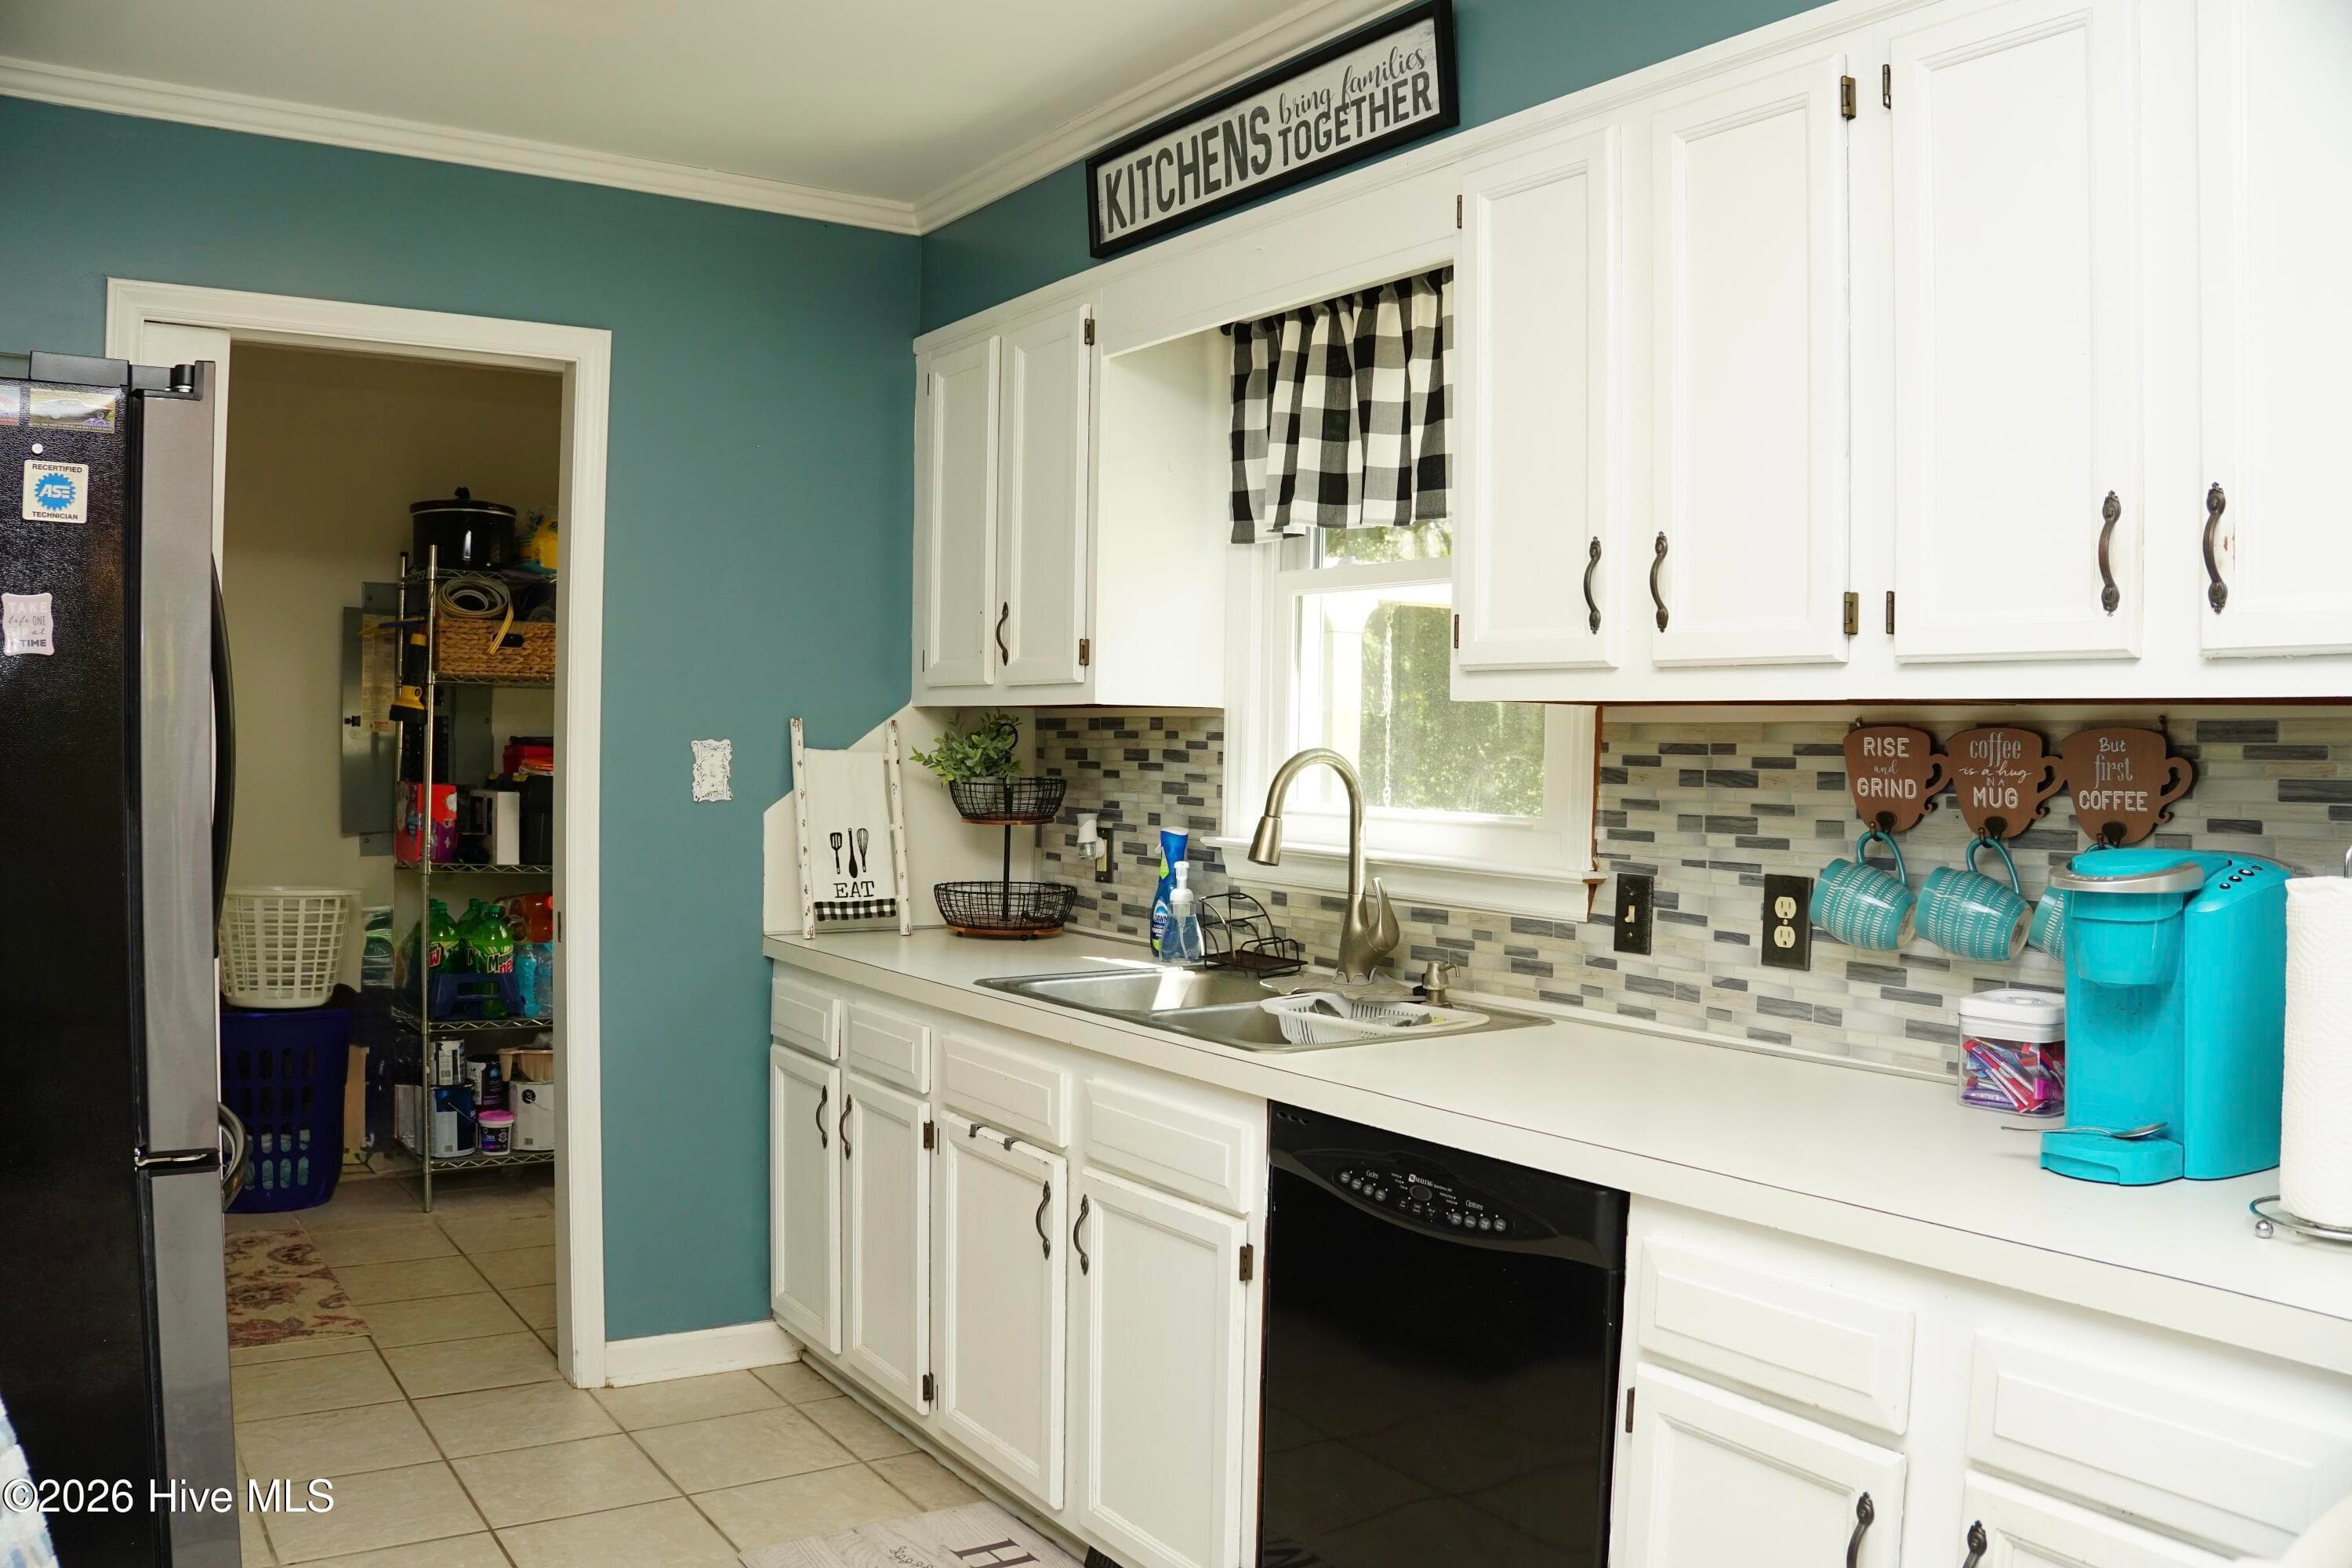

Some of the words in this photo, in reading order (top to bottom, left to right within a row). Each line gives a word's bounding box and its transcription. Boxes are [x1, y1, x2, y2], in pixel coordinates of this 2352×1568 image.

[1279, 86, 1334, 127] bring
[1341, 45, 1426, 115] families
[1105, 106, 1273, 234] KITCHENS
[1278, 71, 1432, 167] TOGETHER
[32, 463, 82, 474] RECERTIFIED
[39, 484, 71, 499] ASE
[32, 511, 78, 520] TECHNICIAN
[8, 601, 48, 613] TAKE
[9, 615, 30, 626] life
[32, 615, 45, 626] ONE
[19, 639, 47, 648] TIME
[1864, 736, 1910, 758] RISE
[1969, 731, 2021, 768] coffee
[2099, 737, 2126, 753] But
[1874, 759, 1899, 775] and
[1958, 767, 1979, 775] is
[1995, 760, 2032, 784] hug
[2093, 753, 2132, 789] first
[1857, 777, 1918, 800] GRIND
[1973, 786, 2019, 809] MUG
[2079, 789, 2148, 812] COFFEE
[833, 880, 875, 898] EAT
[1154, 913, 1167, 924] DAWN
[1465, 1200, 1483, 1210] Options
